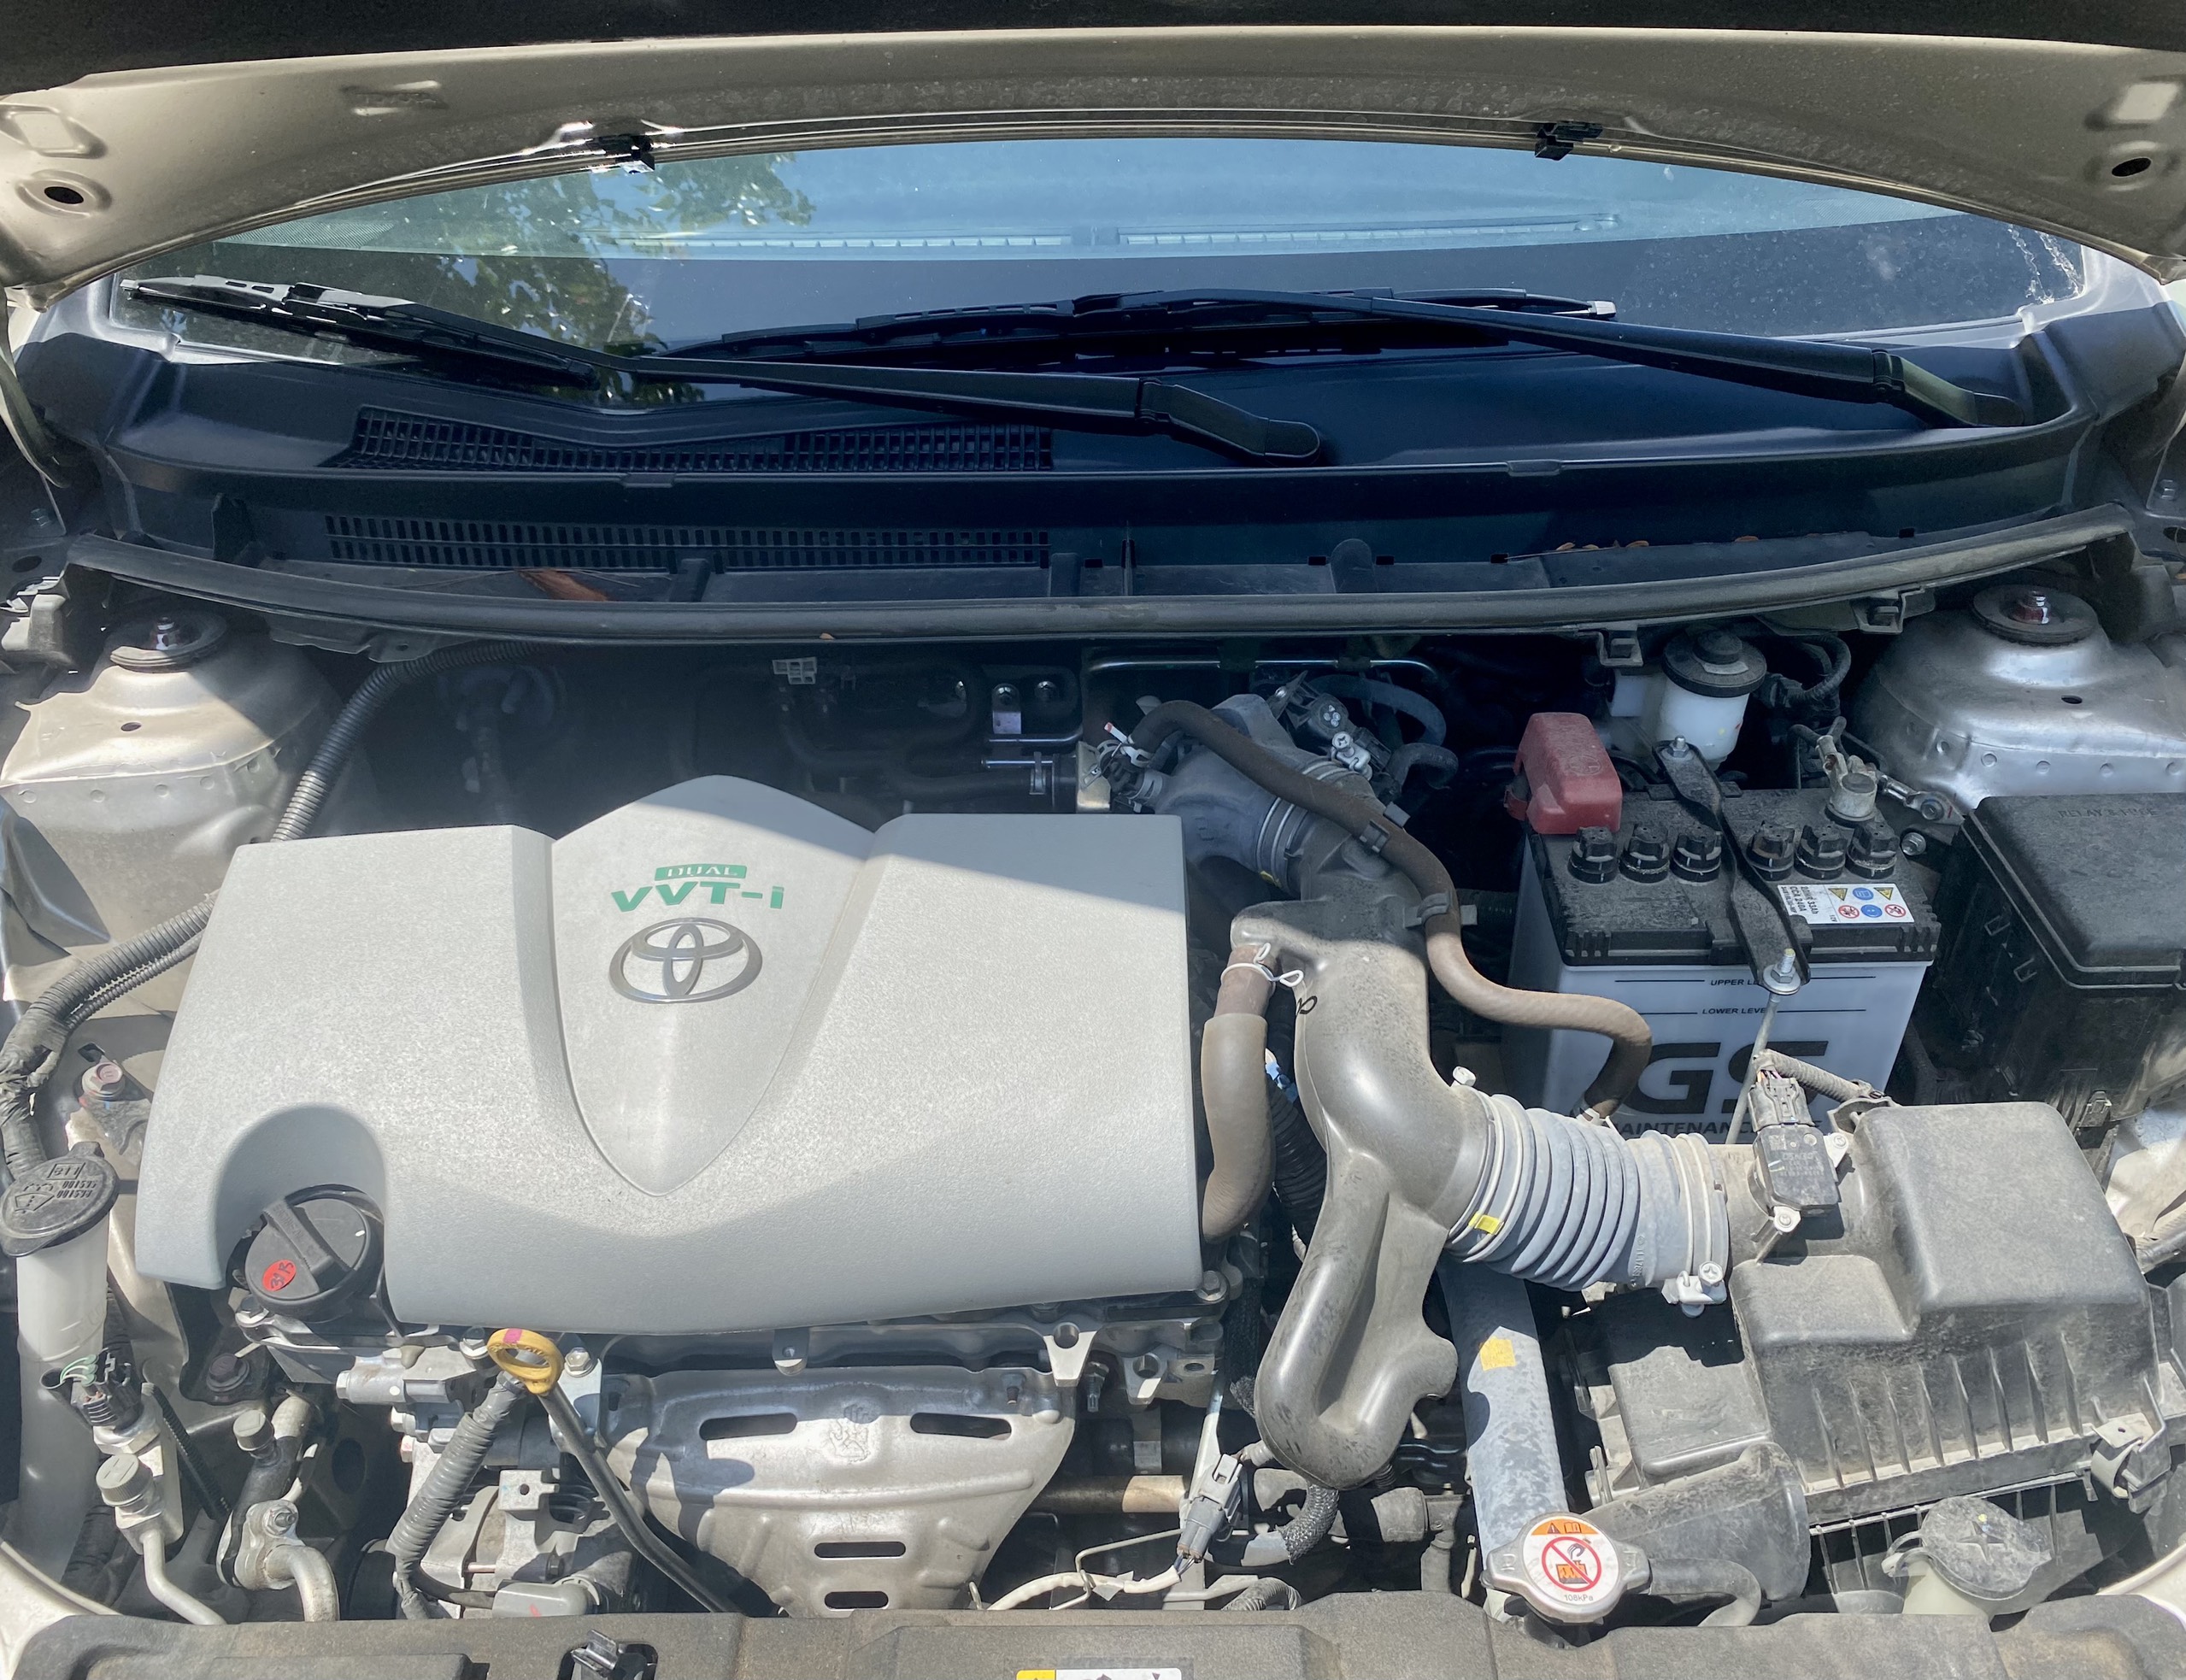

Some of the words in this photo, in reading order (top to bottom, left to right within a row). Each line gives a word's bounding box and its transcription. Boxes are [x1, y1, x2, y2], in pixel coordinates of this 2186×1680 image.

[667, 866, 738, 878] DUAL
[610, 881, 784, 913] VVT-i
[1789, 885, 1801, 897] CCA
[1564, 1593, 1595, 1602] 108kPa
